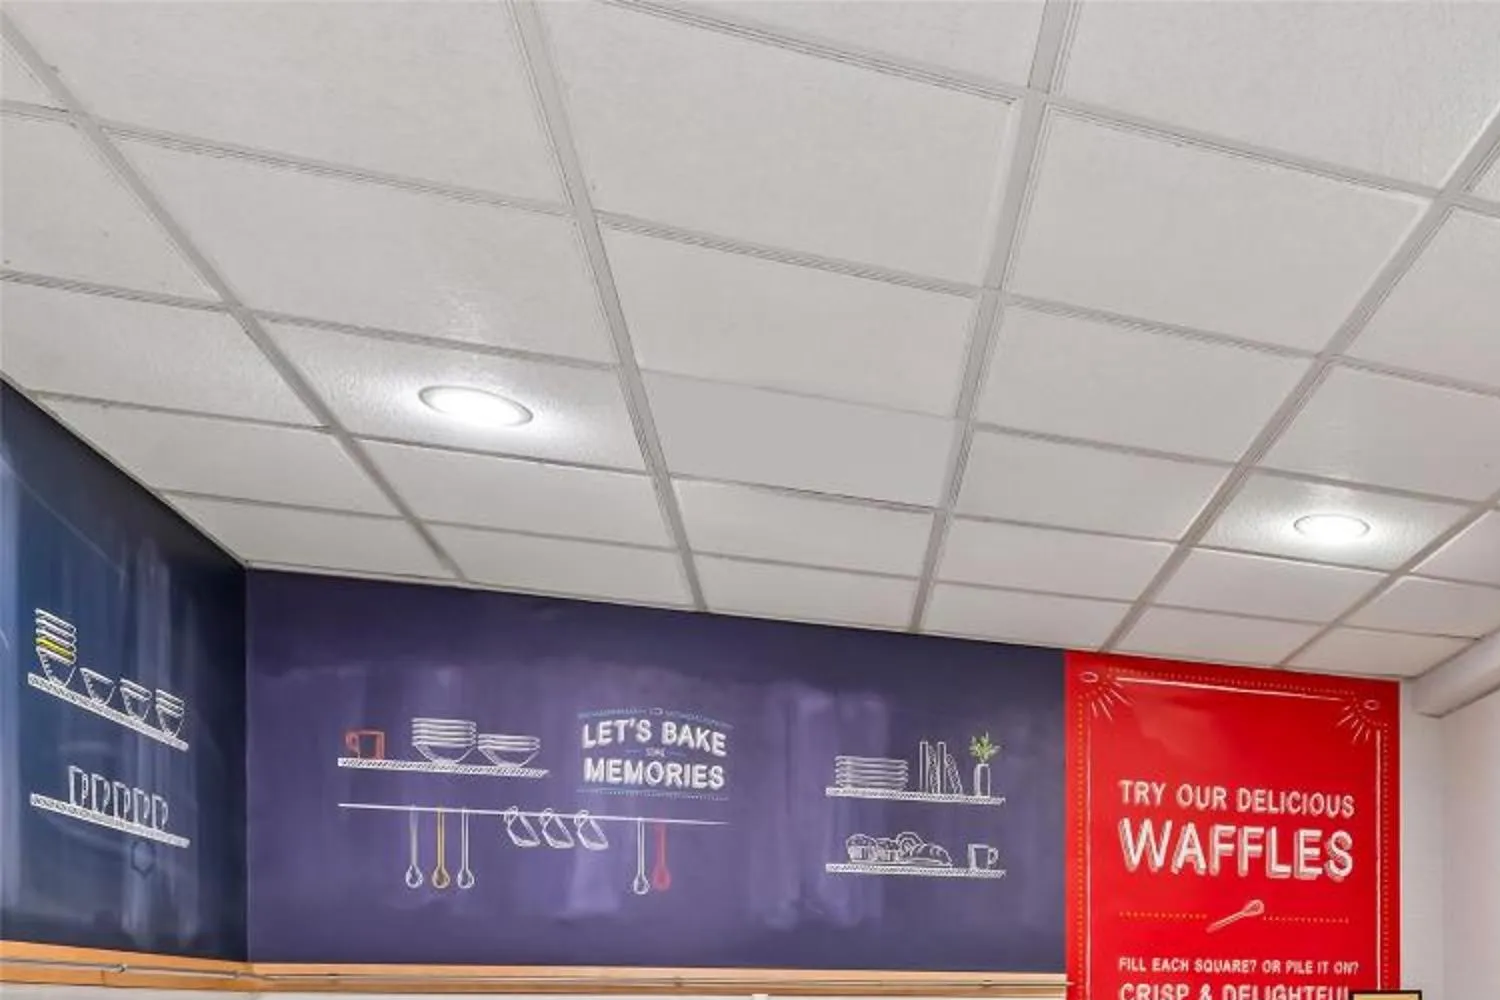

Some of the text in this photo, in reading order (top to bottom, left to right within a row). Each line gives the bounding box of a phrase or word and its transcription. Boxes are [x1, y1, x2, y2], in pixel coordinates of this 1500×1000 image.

[582, 718, 727, 757] LET'S BAKE
[583, 757, 725, 790] MEMORIES
[1118, 779, 1356, 819] TRY OUR DELICIOUS
[1118, 817, 1354, 883] WAFFLES
[1118, 956, 1359, 976] FILL EACH SQUARE? OR PILE IT ON?
